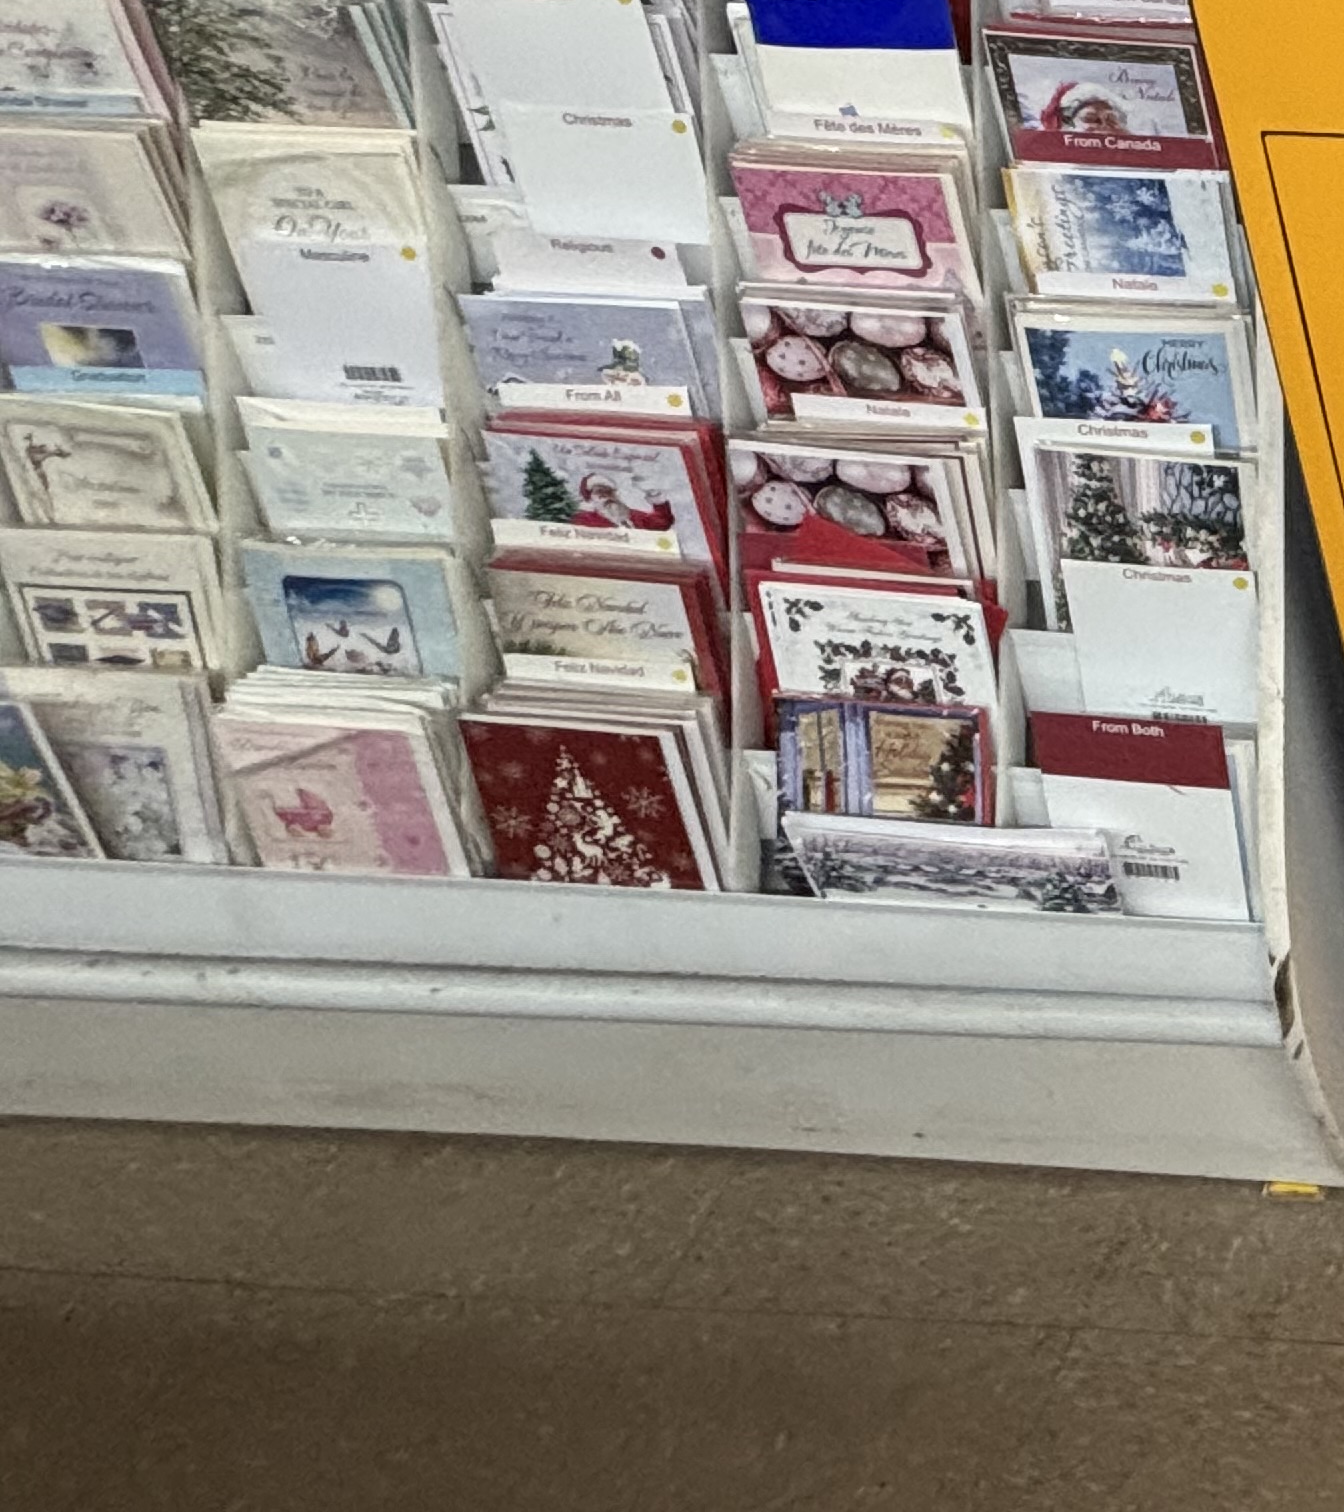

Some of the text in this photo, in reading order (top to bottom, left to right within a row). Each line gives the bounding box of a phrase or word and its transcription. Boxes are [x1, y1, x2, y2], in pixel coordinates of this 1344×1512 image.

[562, 113, 631, 128] Christmas
[814, 118, 849, 134] Fête
[850, 120, 874, 135] des
[1063, 134, 1162, 152] From Canada
[566, 389, 601, 401] From
[1078, 424, 1147, 439] Christmas
[1122, 567, 1192, 584] Christmas
[1092, 720, 1165, 737] From Both
